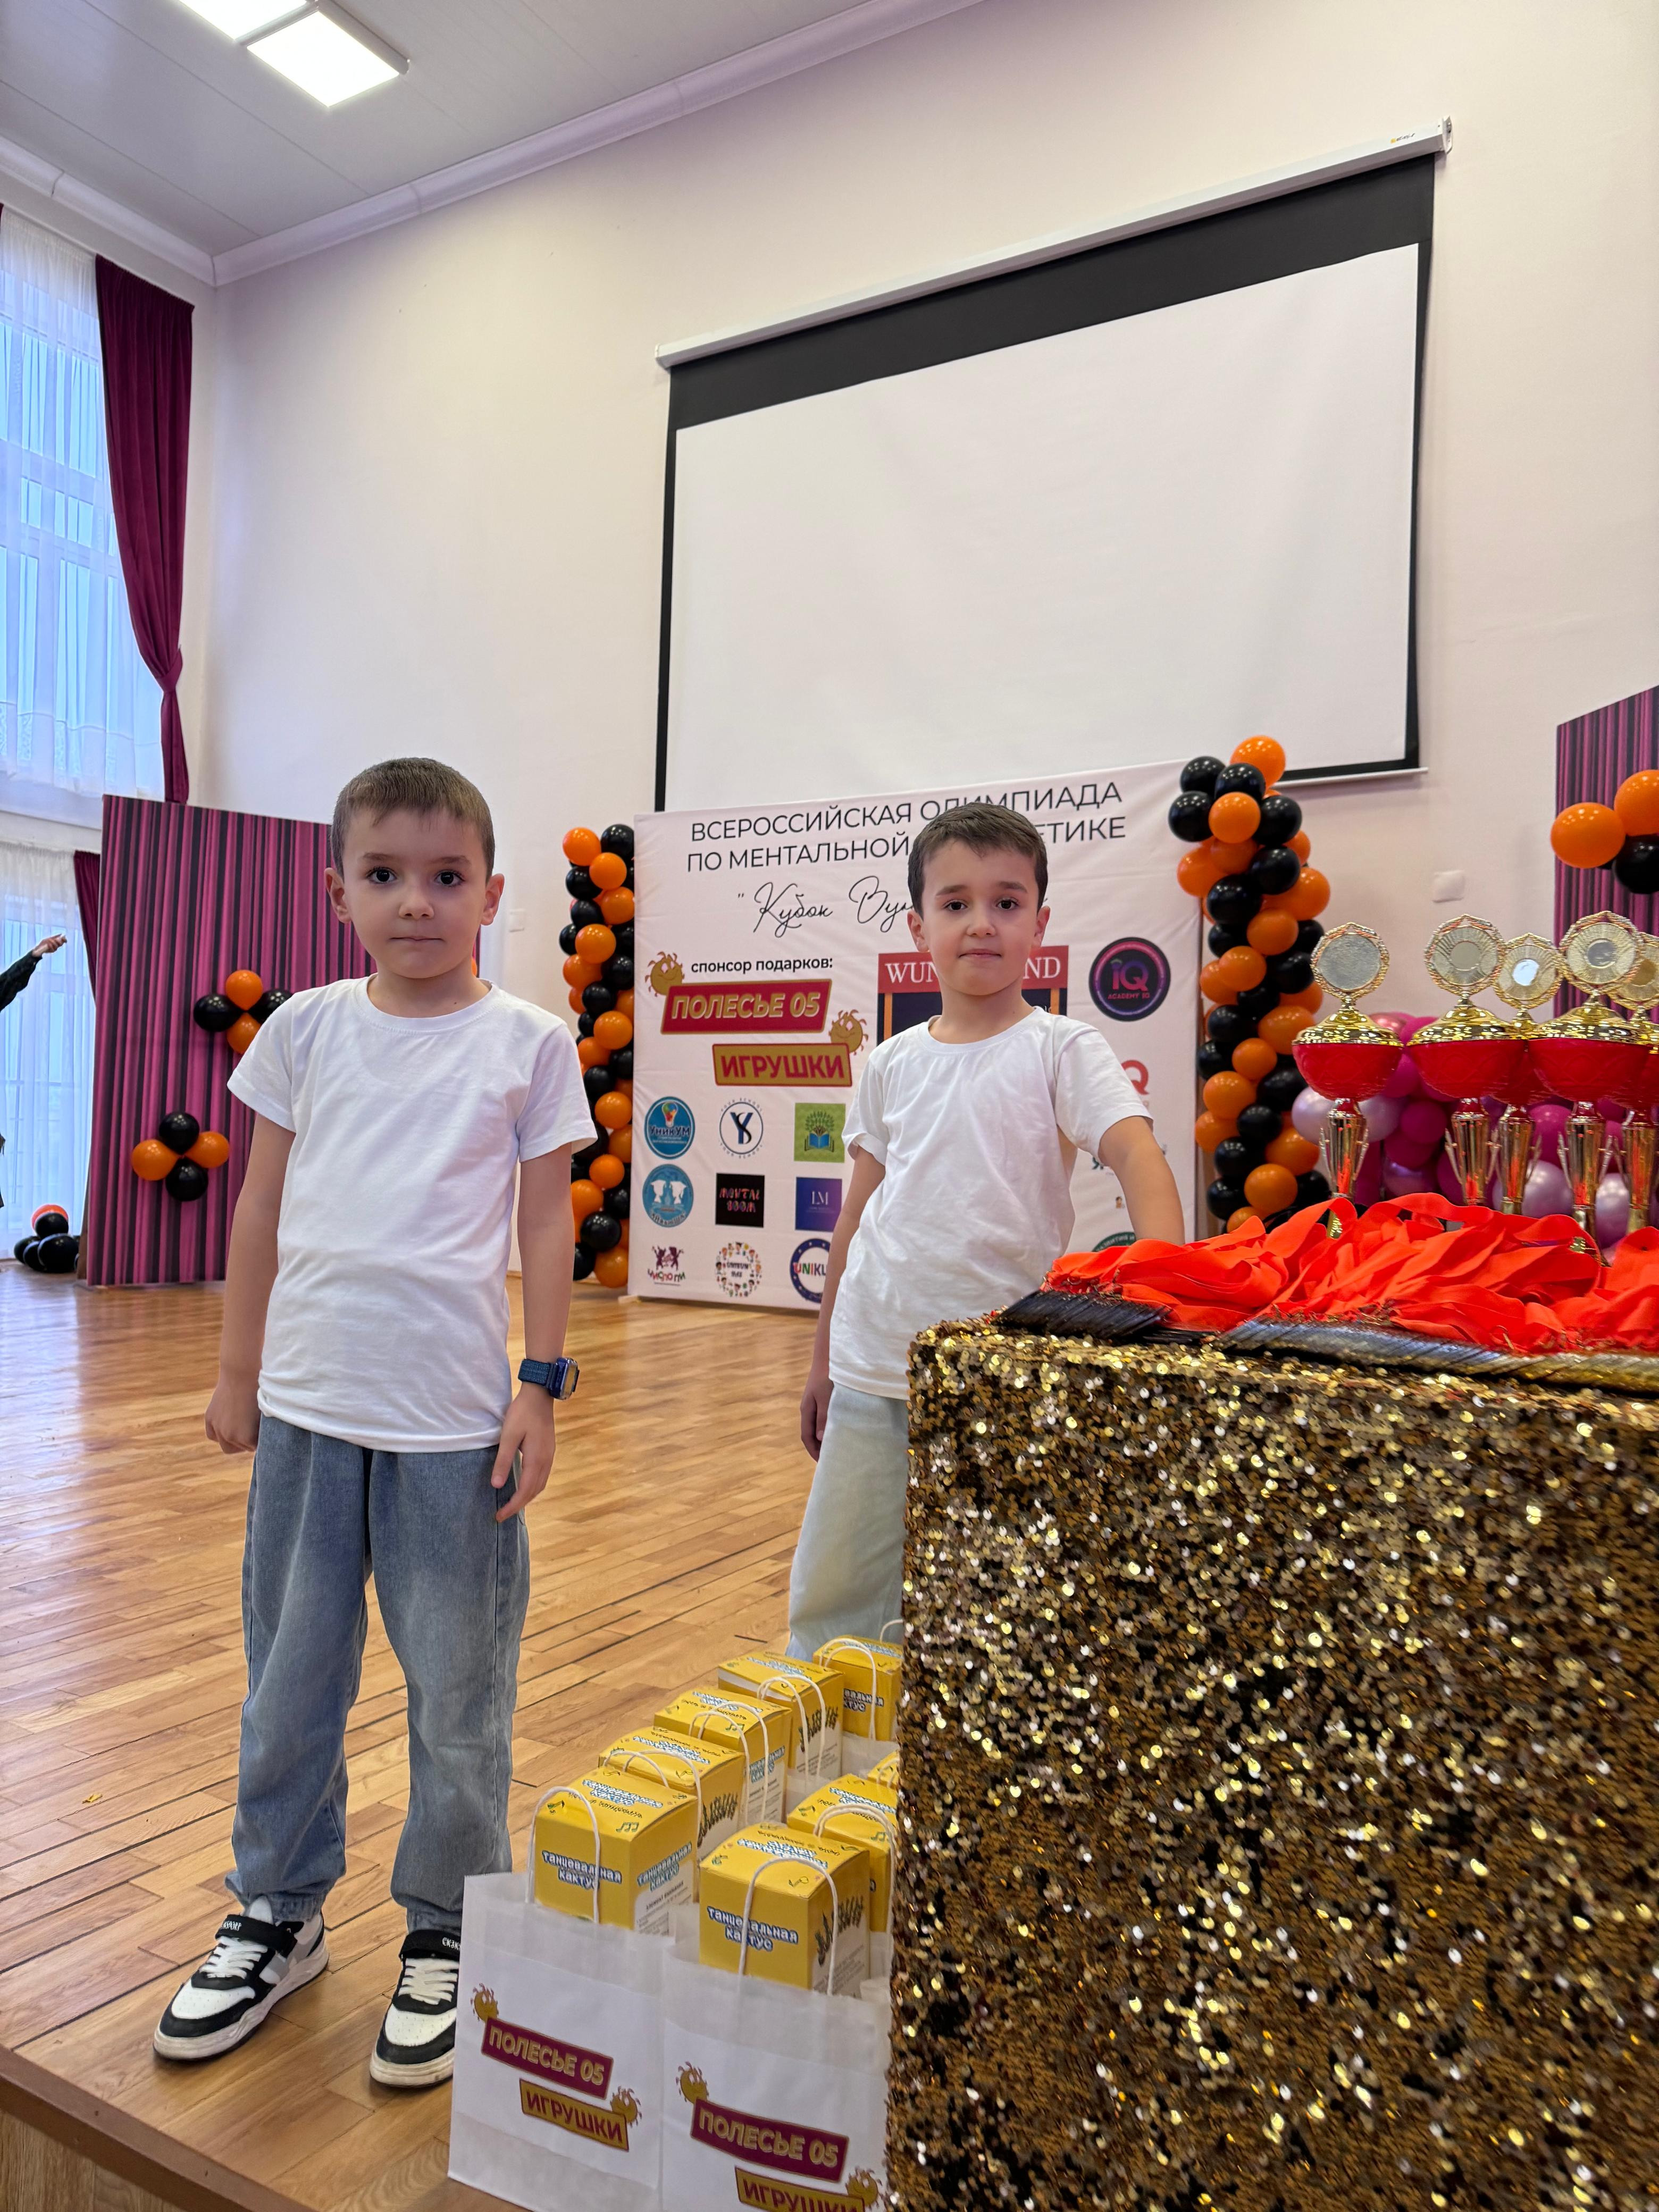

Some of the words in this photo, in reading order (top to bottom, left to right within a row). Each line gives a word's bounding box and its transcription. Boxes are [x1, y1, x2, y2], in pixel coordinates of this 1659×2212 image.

[692, 803, 911, 842] ВСЕРОССИЙСКАЯ
[688, 851, 722, 872] ПО
[730, 831, 909, 869] МЕНТАЛЬНОЙ
[691, 960, 752, 974] спонсор
[756, 958, 833, 973] подарков:
[671, 993, 785, 1019] ПОЛЕСЬЕ
[790, 992, 820, 1017] 05
[720, 1054, 845, 1079] ИГРУШКИ
[793, 1262, 826, 1276] UNIKL
[489, 2025, 577, 2077] ПОЛЕСЬЕ
[580, 2059, 605, 2085] 05
[526, 2090, 623, 2143] ИГРУШКИ
[699, 2107, 806, 2161] ПОЛЕСЬЕ
[809, 2139, 839, 2168] 05
